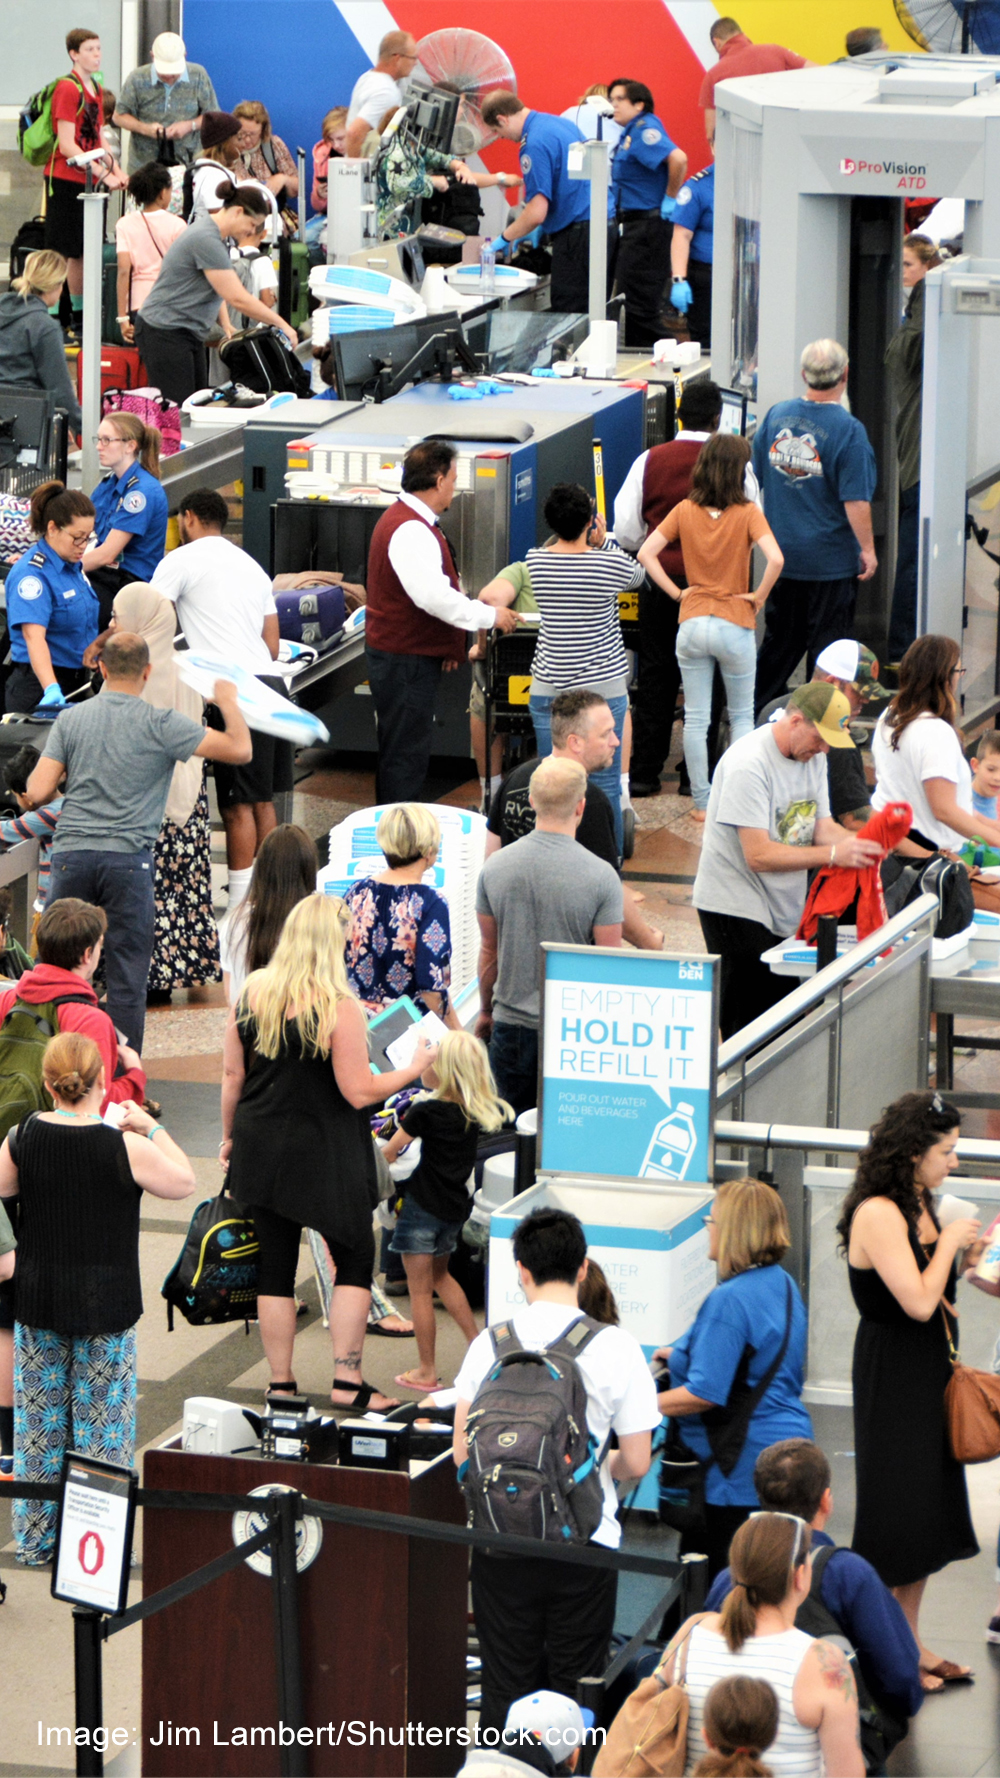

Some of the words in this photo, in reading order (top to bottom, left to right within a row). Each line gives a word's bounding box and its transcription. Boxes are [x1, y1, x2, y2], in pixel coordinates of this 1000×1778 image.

[858, 160, 926, 175] ProVision
[897, 177, 926, 190] ATD
[595, 452, 602, 476] 30
[678, 969, 703, 981] DEN
[561, 987, 661, 1017] EMPTY
[671, 995, 695, 1019] IT
[561, 1017, 653, 1048] HOLD
[665, 1025, 695, 1051] IT
[560, 1049, 658, 1078] REFILL
[669, 1057, 694, 1080] IT
[558, 1092, 587, 1103] POUR
[588, 1094, 610, 1104] OUT
[611, 1097, 647, 1107] WATER
[558, 1104, 580, 1114] AND
[581, 1105, 639, 1119] BEVERAGES
[558, 1115, 584, 1126] HERE
[601, 1263, 639, 1277] ATER
